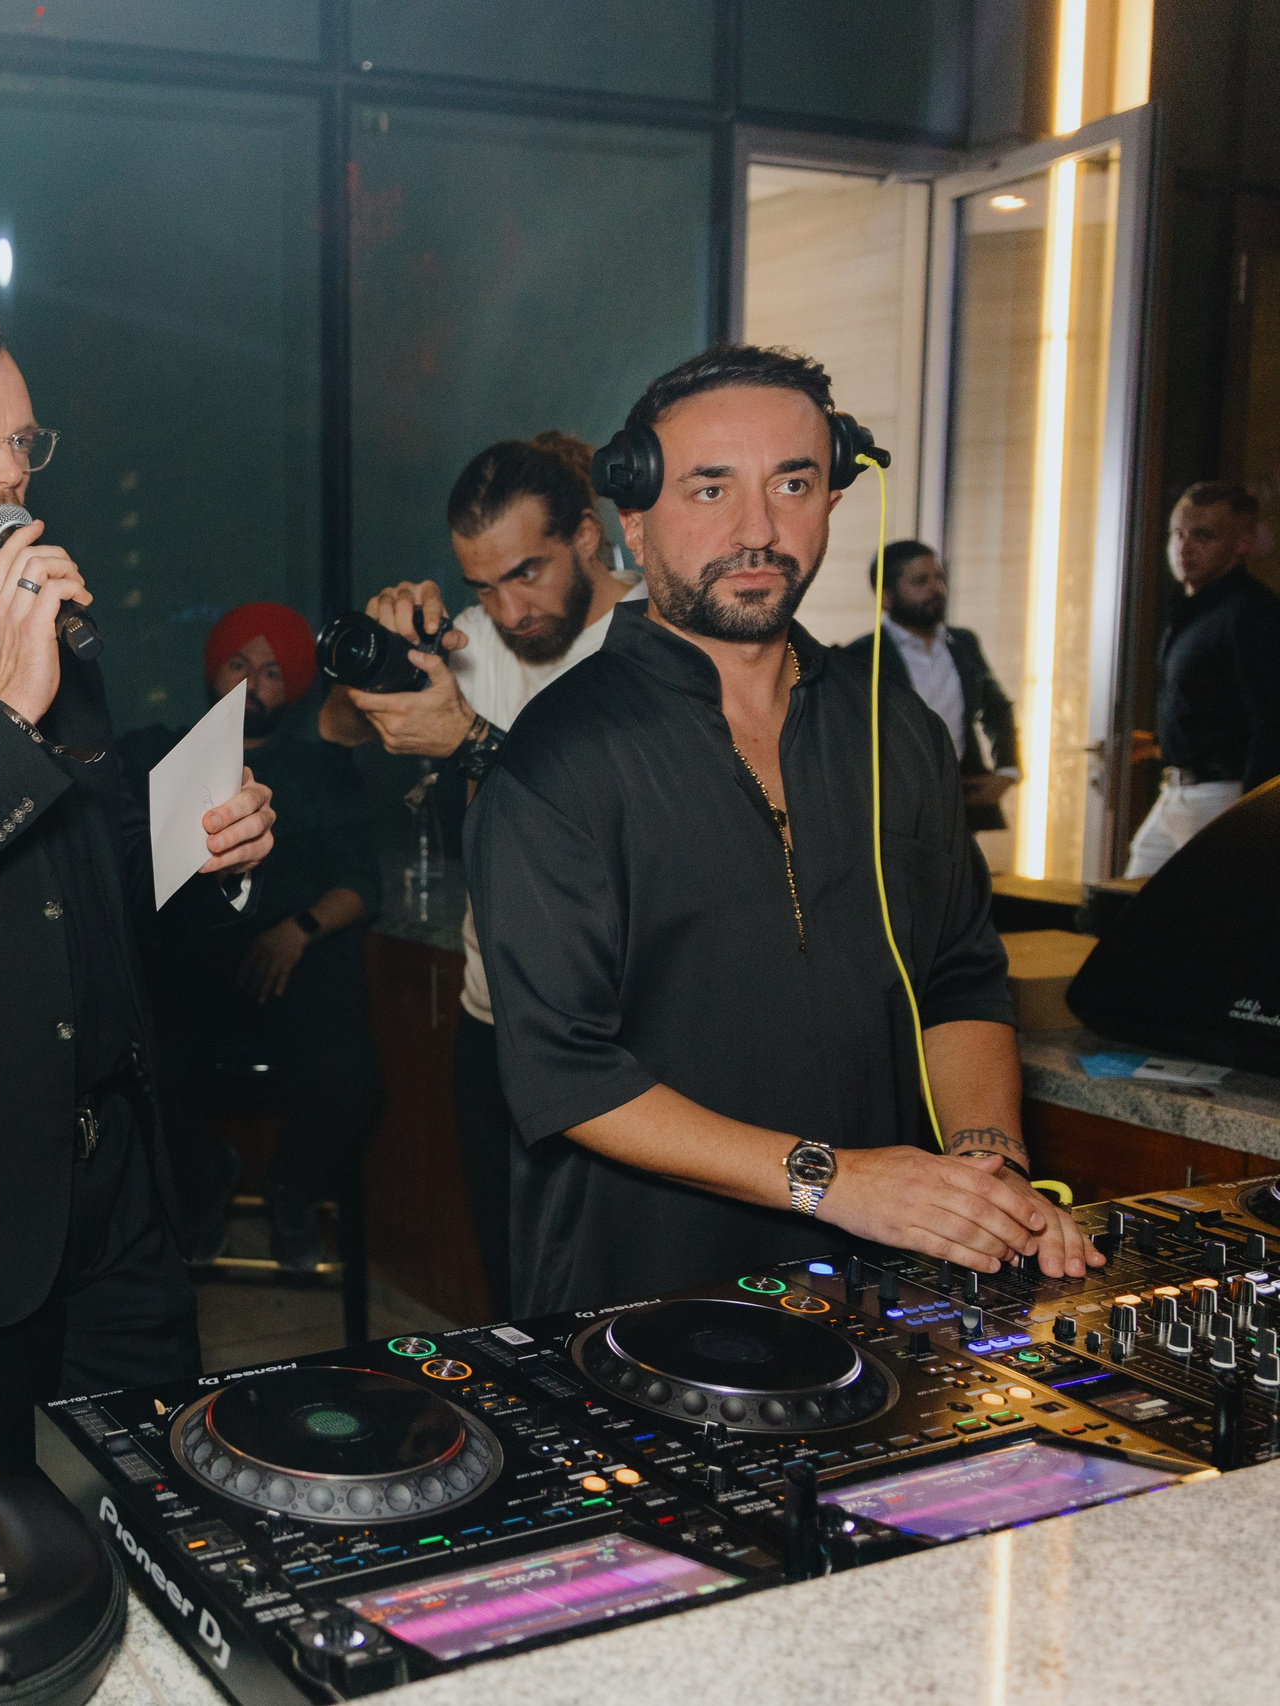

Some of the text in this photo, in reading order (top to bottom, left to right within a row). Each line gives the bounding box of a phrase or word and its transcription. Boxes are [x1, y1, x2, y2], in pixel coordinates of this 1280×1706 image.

[10, 715, 29, 731] NEW
[47, 1395, 88, 1407] CDJ-3000
[99, 1495, 195, 1618] Pioneer
